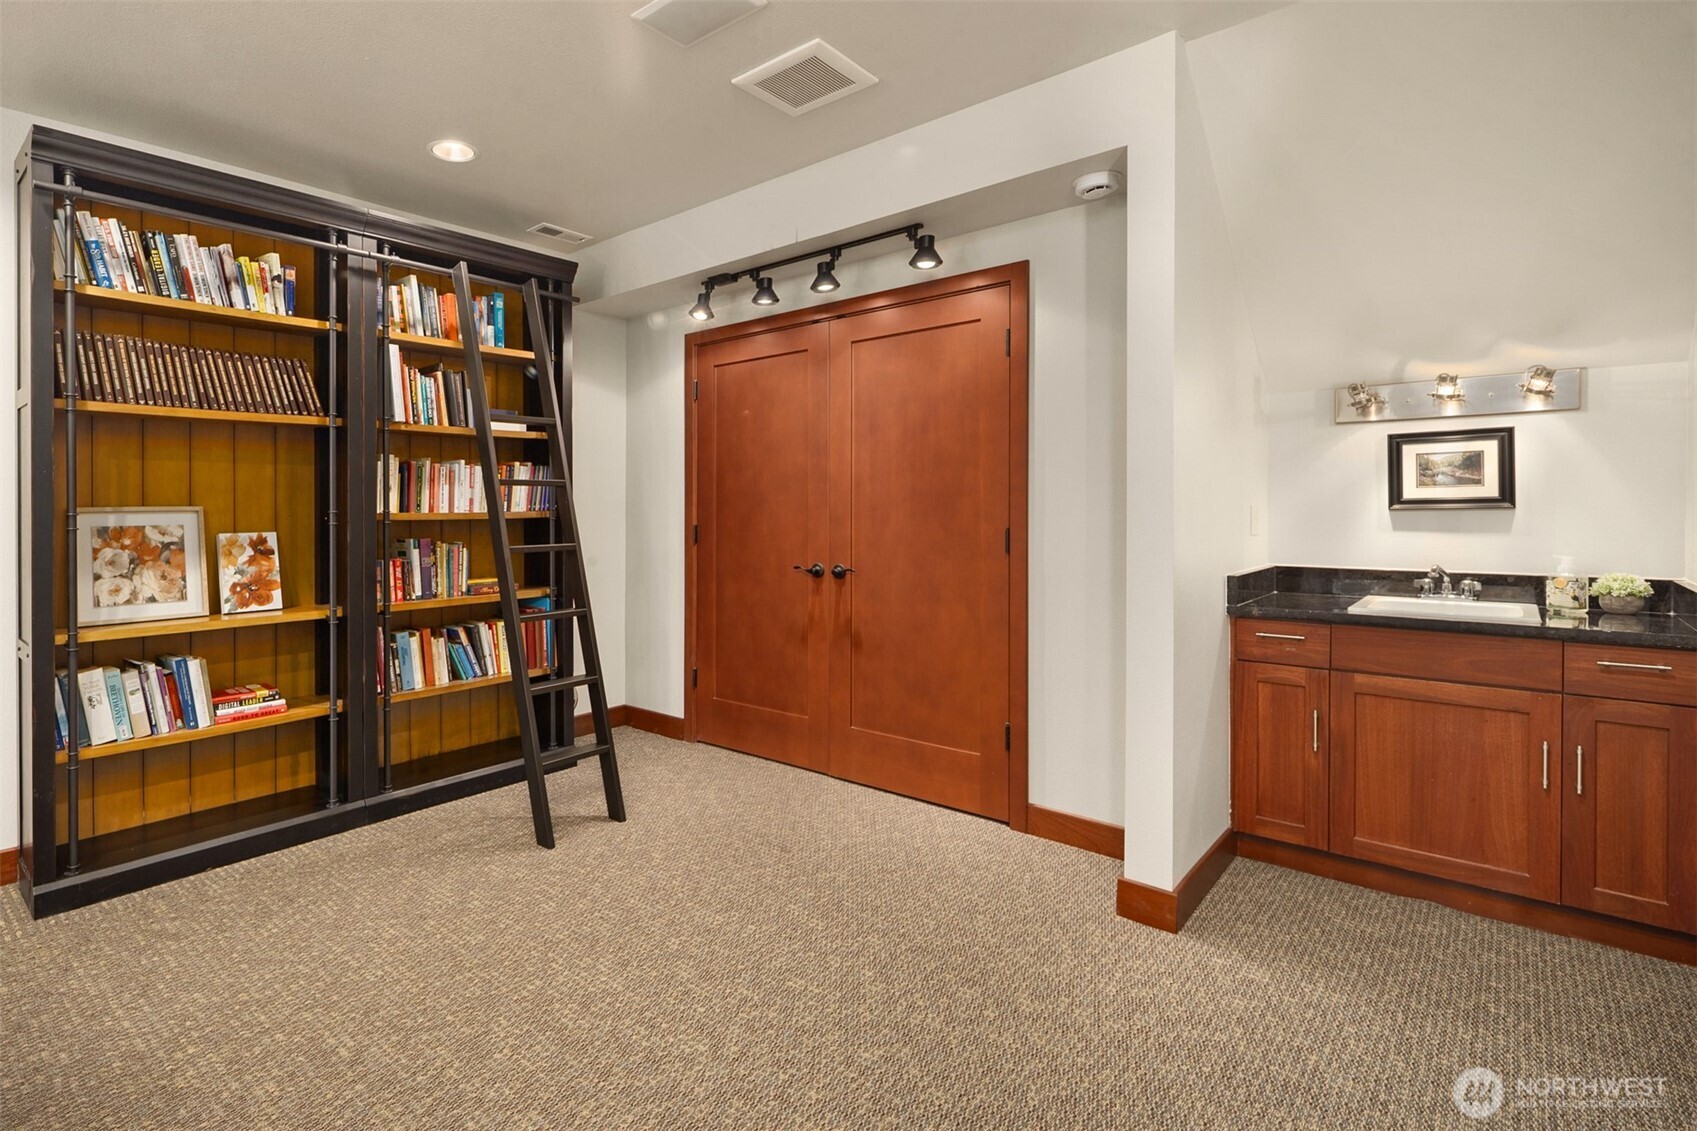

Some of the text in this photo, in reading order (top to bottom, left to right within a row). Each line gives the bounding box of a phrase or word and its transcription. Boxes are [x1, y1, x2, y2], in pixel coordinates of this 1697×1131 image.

[95, 258, 108, 278] HABIT
[148, 248, 171, 296] DIGITAL LEADER
[109, 684, 123, 726] BEETHOVEN
[218, 701, 241, 711] DIGITAL
[242, 697, 264, 708] LEADER
